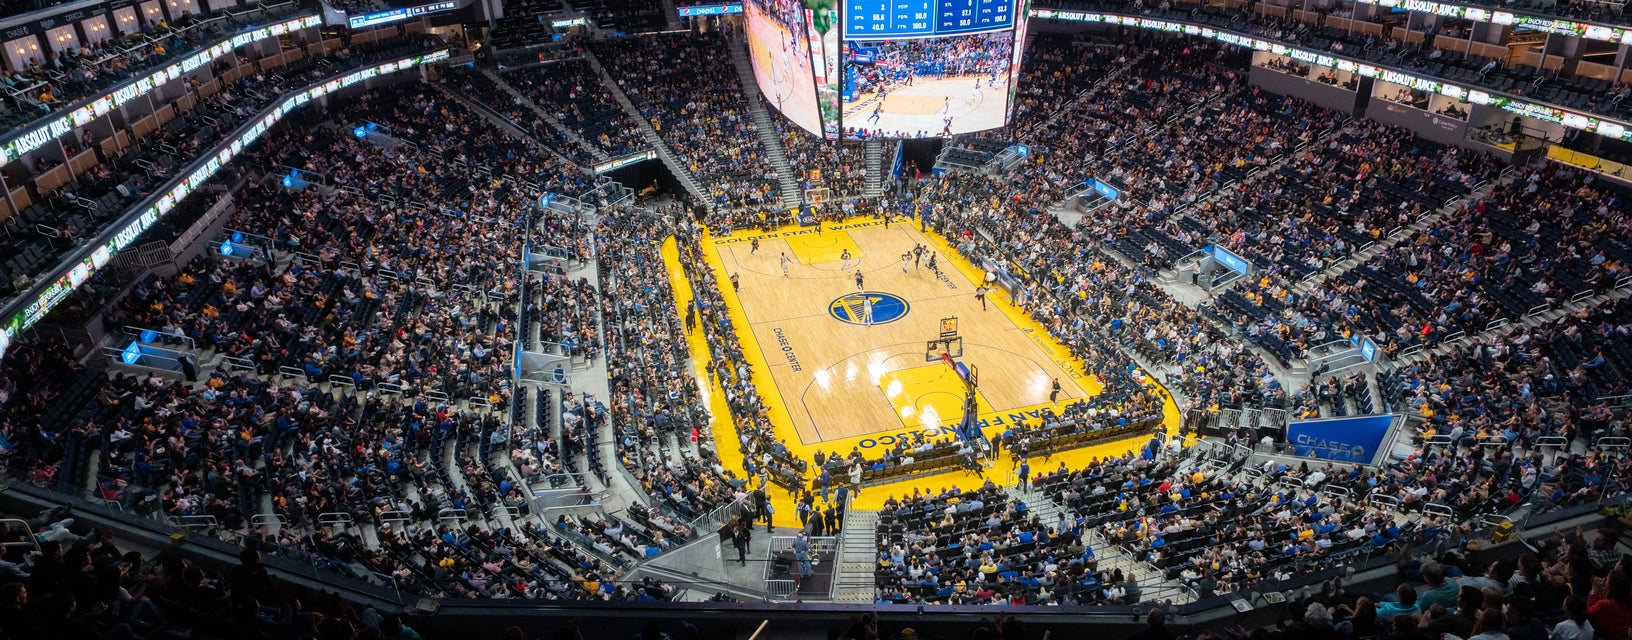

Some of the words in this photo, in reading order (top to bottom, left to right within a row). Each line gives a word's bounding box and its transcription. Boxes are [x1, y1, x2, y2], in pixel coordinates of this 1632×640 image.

[1404, 0, 1436, 12] ABSOLUT
[1437, 5, 1459, 16] JUICE
[306, 15, 322, 26] ABSOL
[1058, 12, 1084, 20] ABSOLUT
[1084, 14, 1100, 22] JUICE
[1141, 19, 1164, 29] ABSOLUT
[1165, 23, 1180, 32] JUICE
[7, 30, 24, 38] CHASE
[1218, 32, 1240, 44] ABSOLUT
[1239, 37, 1252, 47] JUICE
[1291, 50, 1317, 64] ABSOLUT
[1317, 56, 1334, 67] JUICE
[113, 83, 138, 106] ABSOLUT
[136, 75, 152, 96] JUICE
[1382, 72, 1416, 86] ABSOLUT
[1416, 79, 1436, 92] JUICE
[15, 126, 52, 156] ABSOLUT
[50, 116, 72, 138] JUICE
[188, 164, 210, 190] ABSOLUT
[207, 156, 220, 177] JUICE
[114, 218, 142, 250] ABSOLUT
[140, 207, 158, 230] JUICE
[714, 234, 778, 244] GOLDEN
[782, 228, 821, 236] STAT
[774, 328, 790, 347] CHASE
[785, 350, 802, 372] CENTER
[858, 414, 1006, 449] FRNCISCO
[1297, 434, 1350, 452] CHASE
